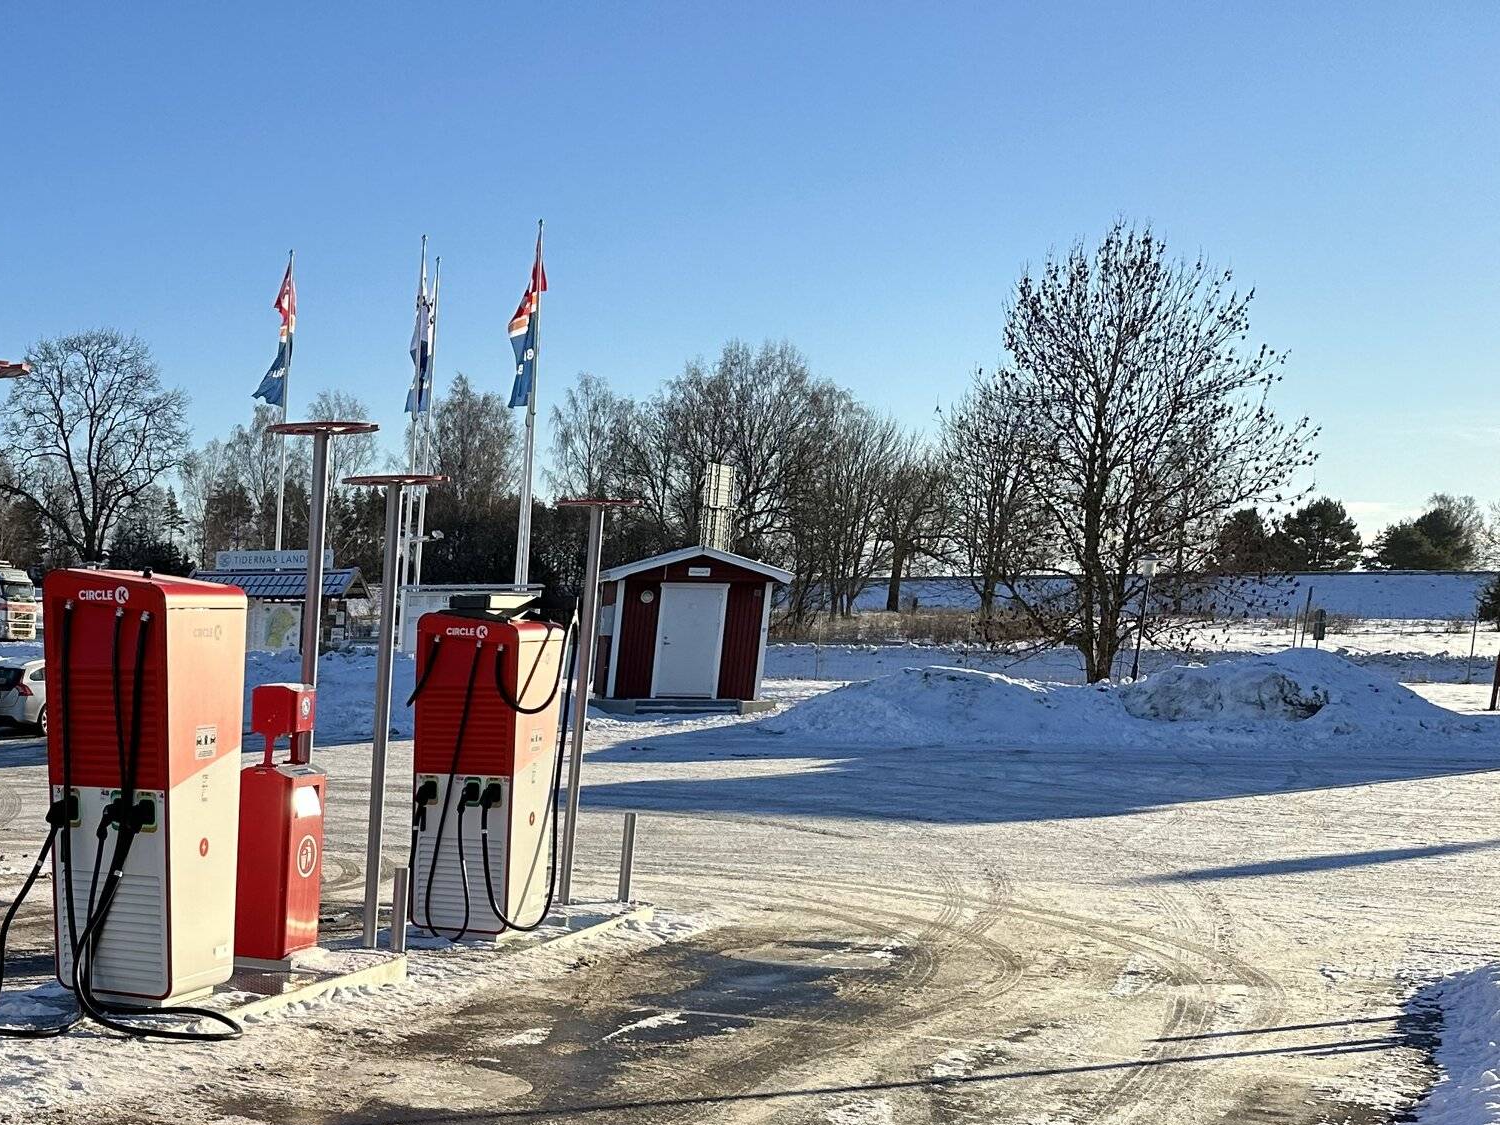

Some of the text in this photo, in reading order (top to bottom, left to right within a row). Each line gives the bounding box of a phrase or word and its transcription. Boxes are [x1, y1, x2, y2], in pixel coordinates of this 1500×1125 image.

[234, 553, 330, 565] TIDERNAS LANDP
[78, 586, 129, 604] CIRCLE K
[446, 625, 488, 639] CIRCLE K
